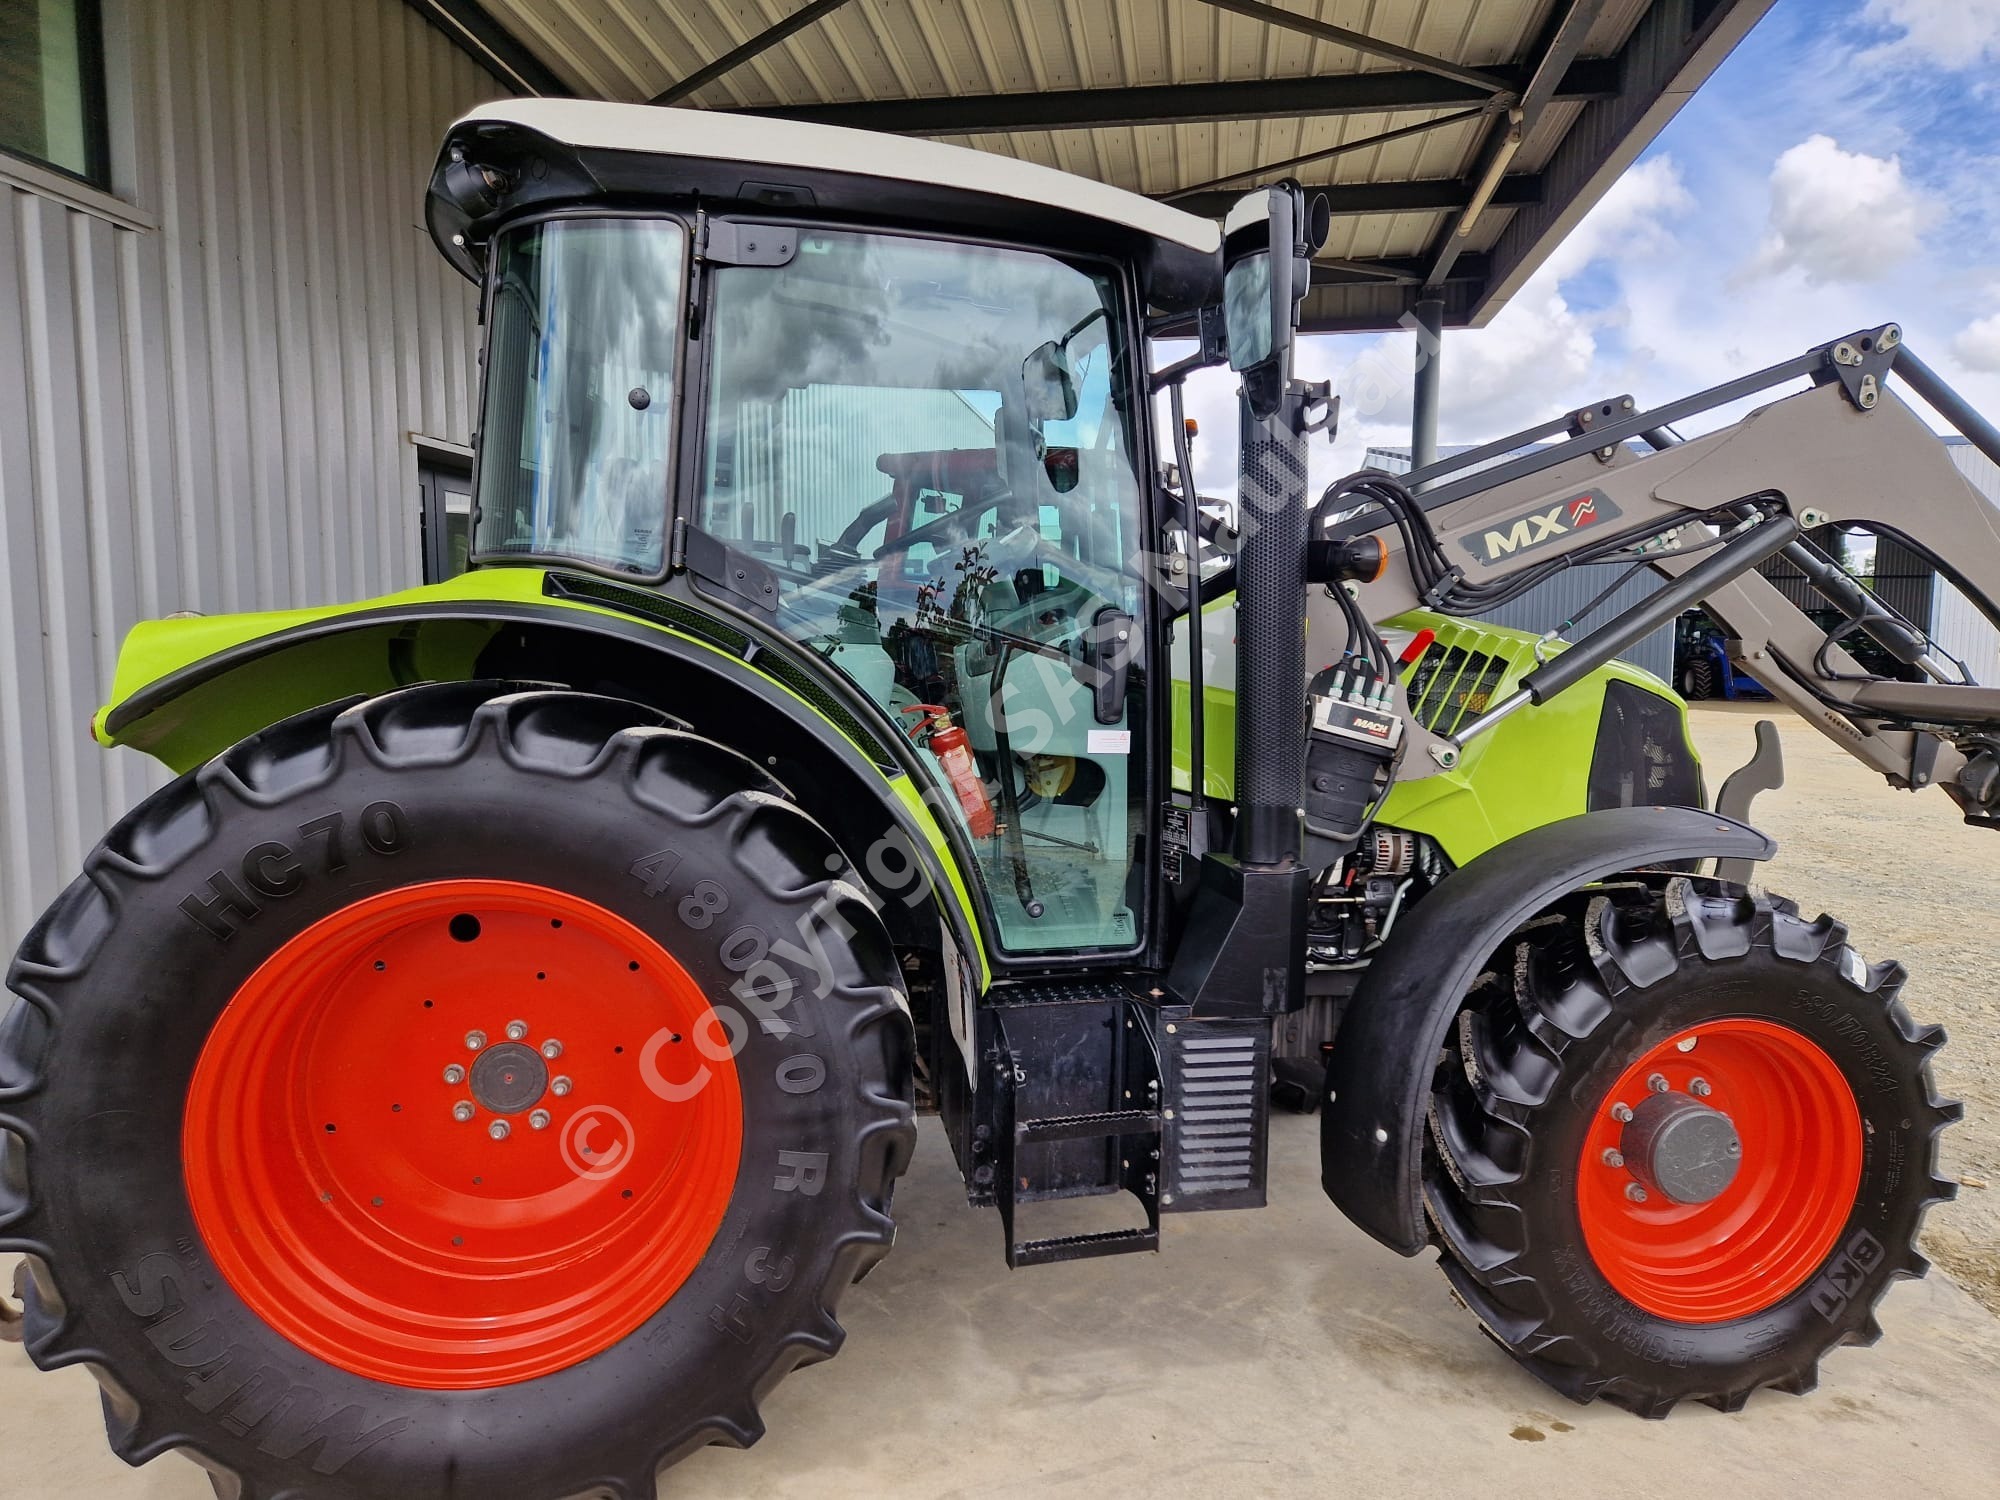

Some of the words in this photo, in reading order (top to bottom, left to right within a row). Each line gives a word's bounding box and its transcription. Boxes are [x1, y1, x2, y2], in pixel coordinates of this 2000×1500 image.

[1484, 505, 1569, 560] MX
[1353, 718, 1389, 734] MACH
[178, 800, 407, 942] HC70
[629, 848, 826, 1094] 480/70
[773, 1150, 829, 1196] R
[709, 1246, 796, 1348] 34
[1813, 1233, 1883, 1319] BKT
